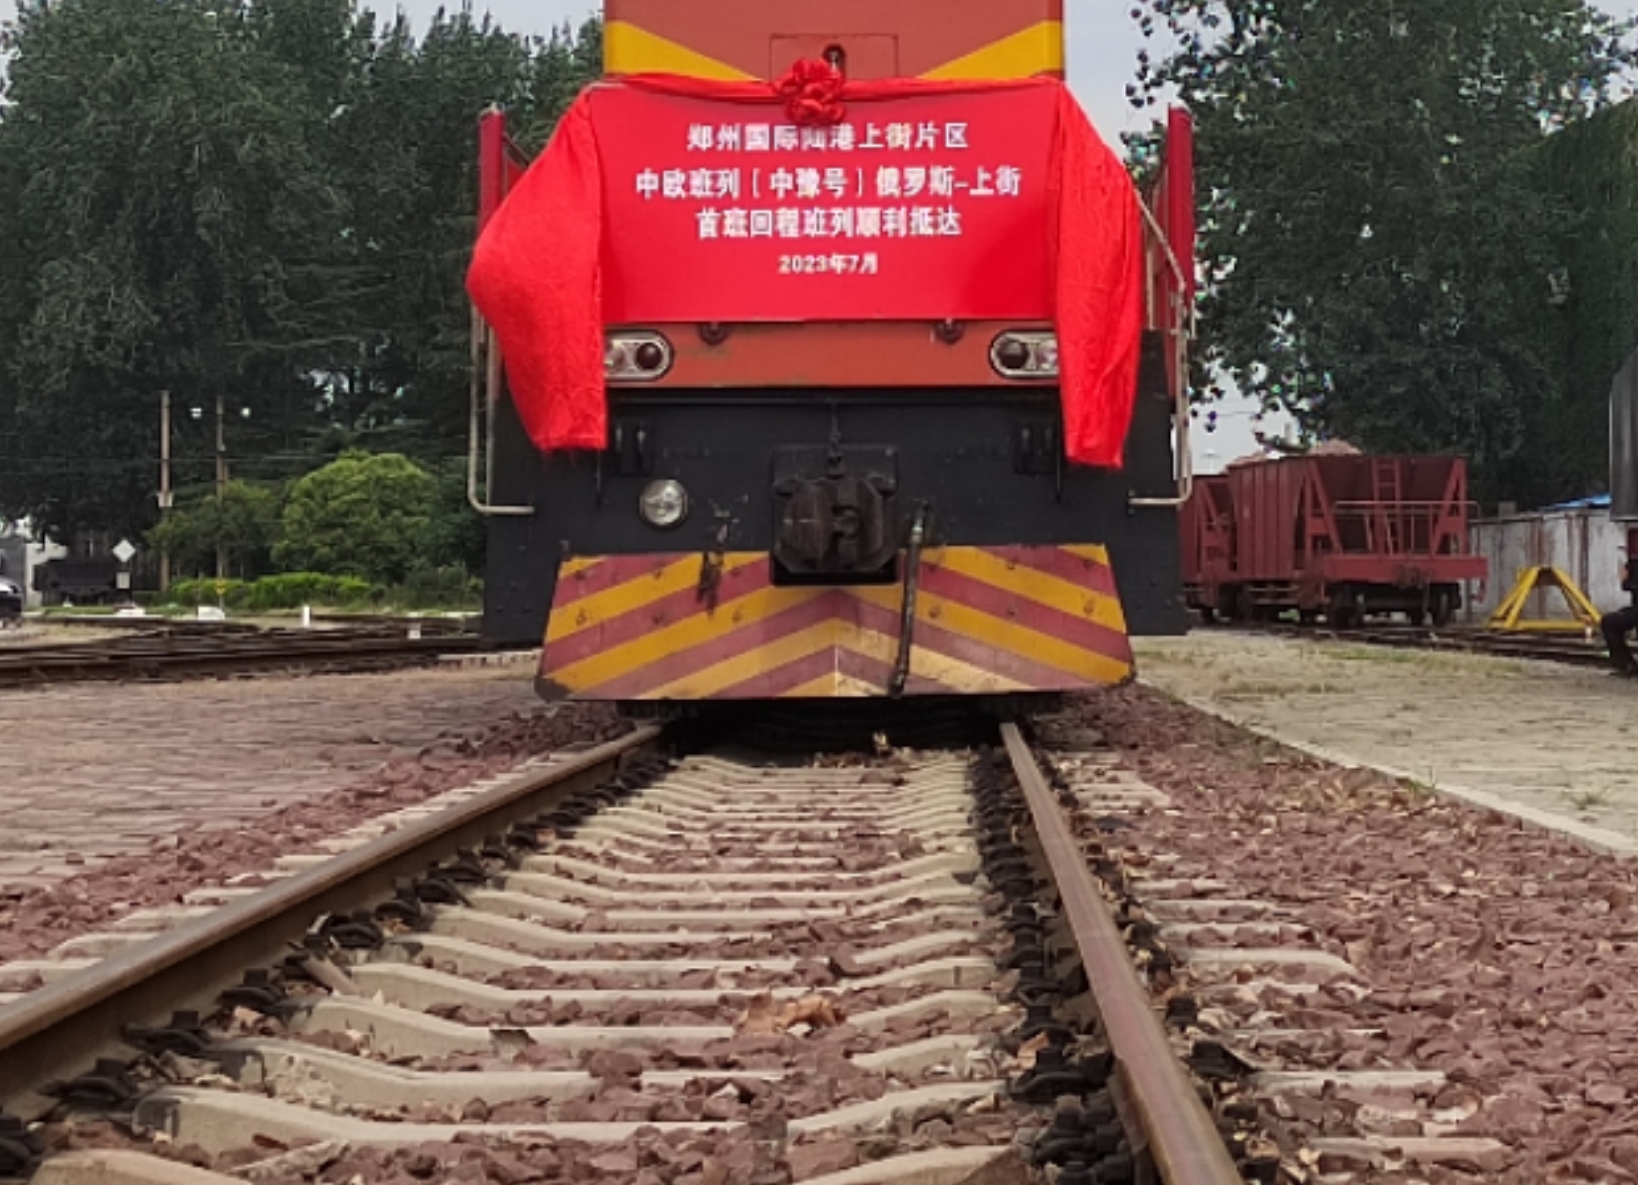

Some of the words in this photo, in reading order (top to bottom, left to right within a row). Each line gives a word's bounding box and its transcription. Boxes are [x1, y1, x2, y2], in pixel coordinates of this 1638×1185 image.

[696, 207, 961, 238] 首班回程班列顺利抵达
[779, 252, 878, 274] 2023年7月
